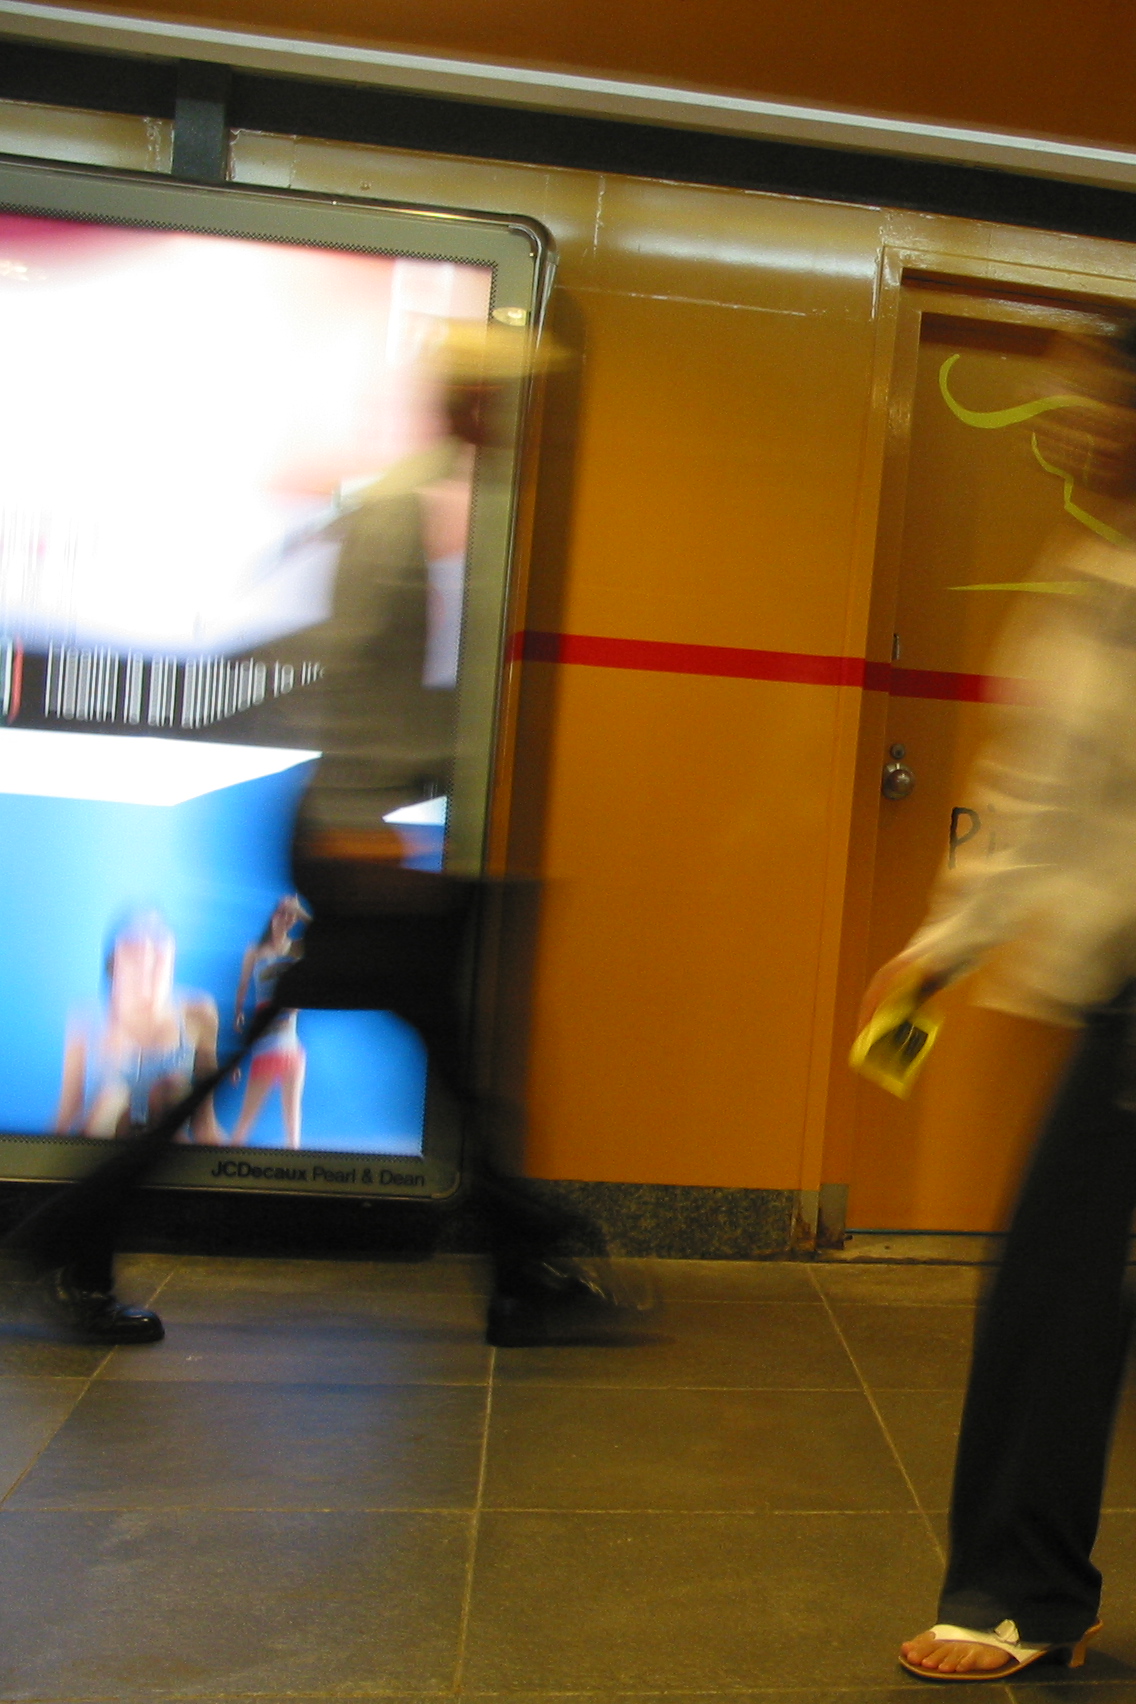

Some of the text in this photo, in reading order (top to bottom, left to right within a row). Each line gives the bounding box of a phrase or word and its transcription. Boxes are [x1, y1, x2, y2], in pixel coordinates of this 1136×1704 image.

[211, 1159, 425, 1187] JCDecaux Pearl & Dean
